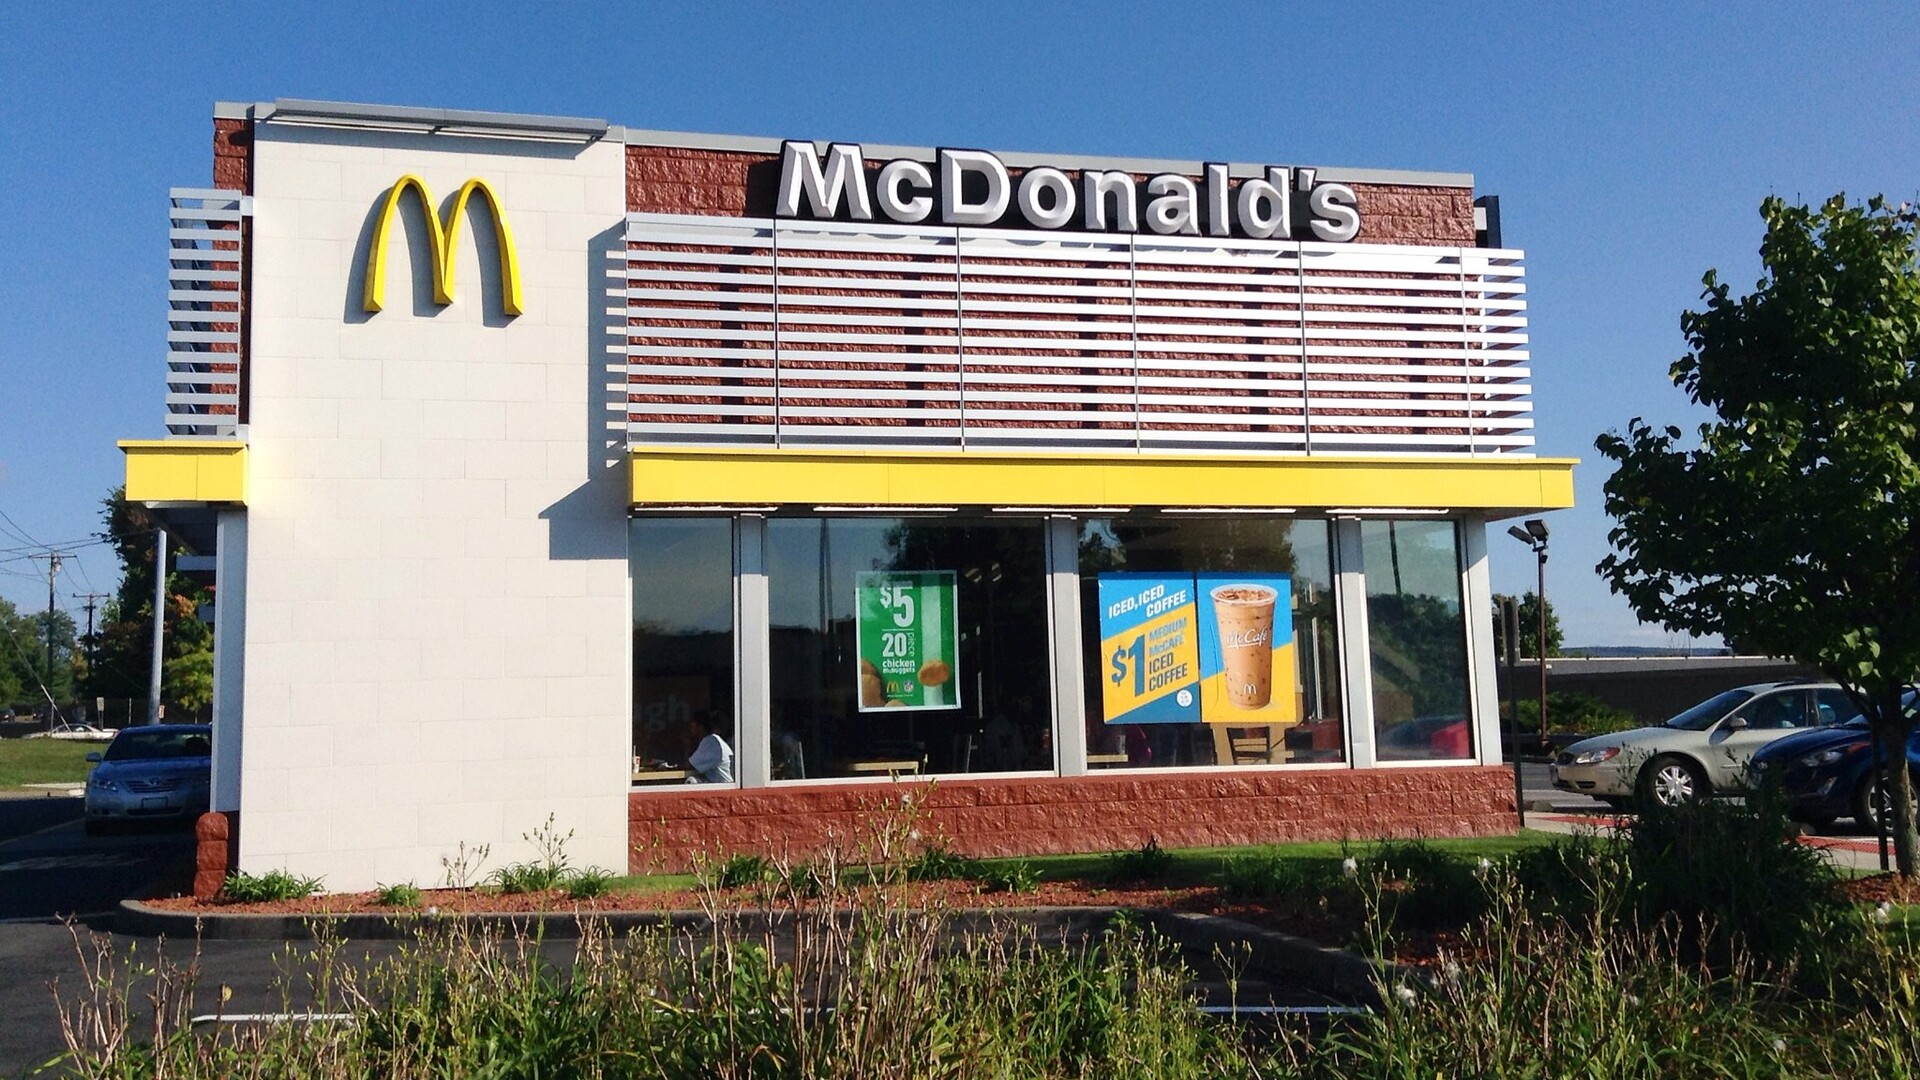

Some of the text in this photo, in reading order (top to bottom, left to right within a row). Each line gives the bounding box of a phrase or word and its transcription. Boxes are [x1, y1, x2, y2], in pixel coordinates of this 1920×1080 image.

[775, 140, 1361, 243] McDonald's
[880, 581, 914, 627] $5
[1109, 584, 1164, 619] ICED, ICED
[1146, 589, 1186, 617] COFFEE
[1149, 617, 1187, 641] MEDIUM
[881, 632, 907, 657] 20
[906, 632, 915, 657] piece
[882, 659, 915, 668] chicken
[1111, 634, 1145, 698] $1
[1149, 652, 1173, 674] ICED
[1149, 663, 1187, 692] COFFEE
